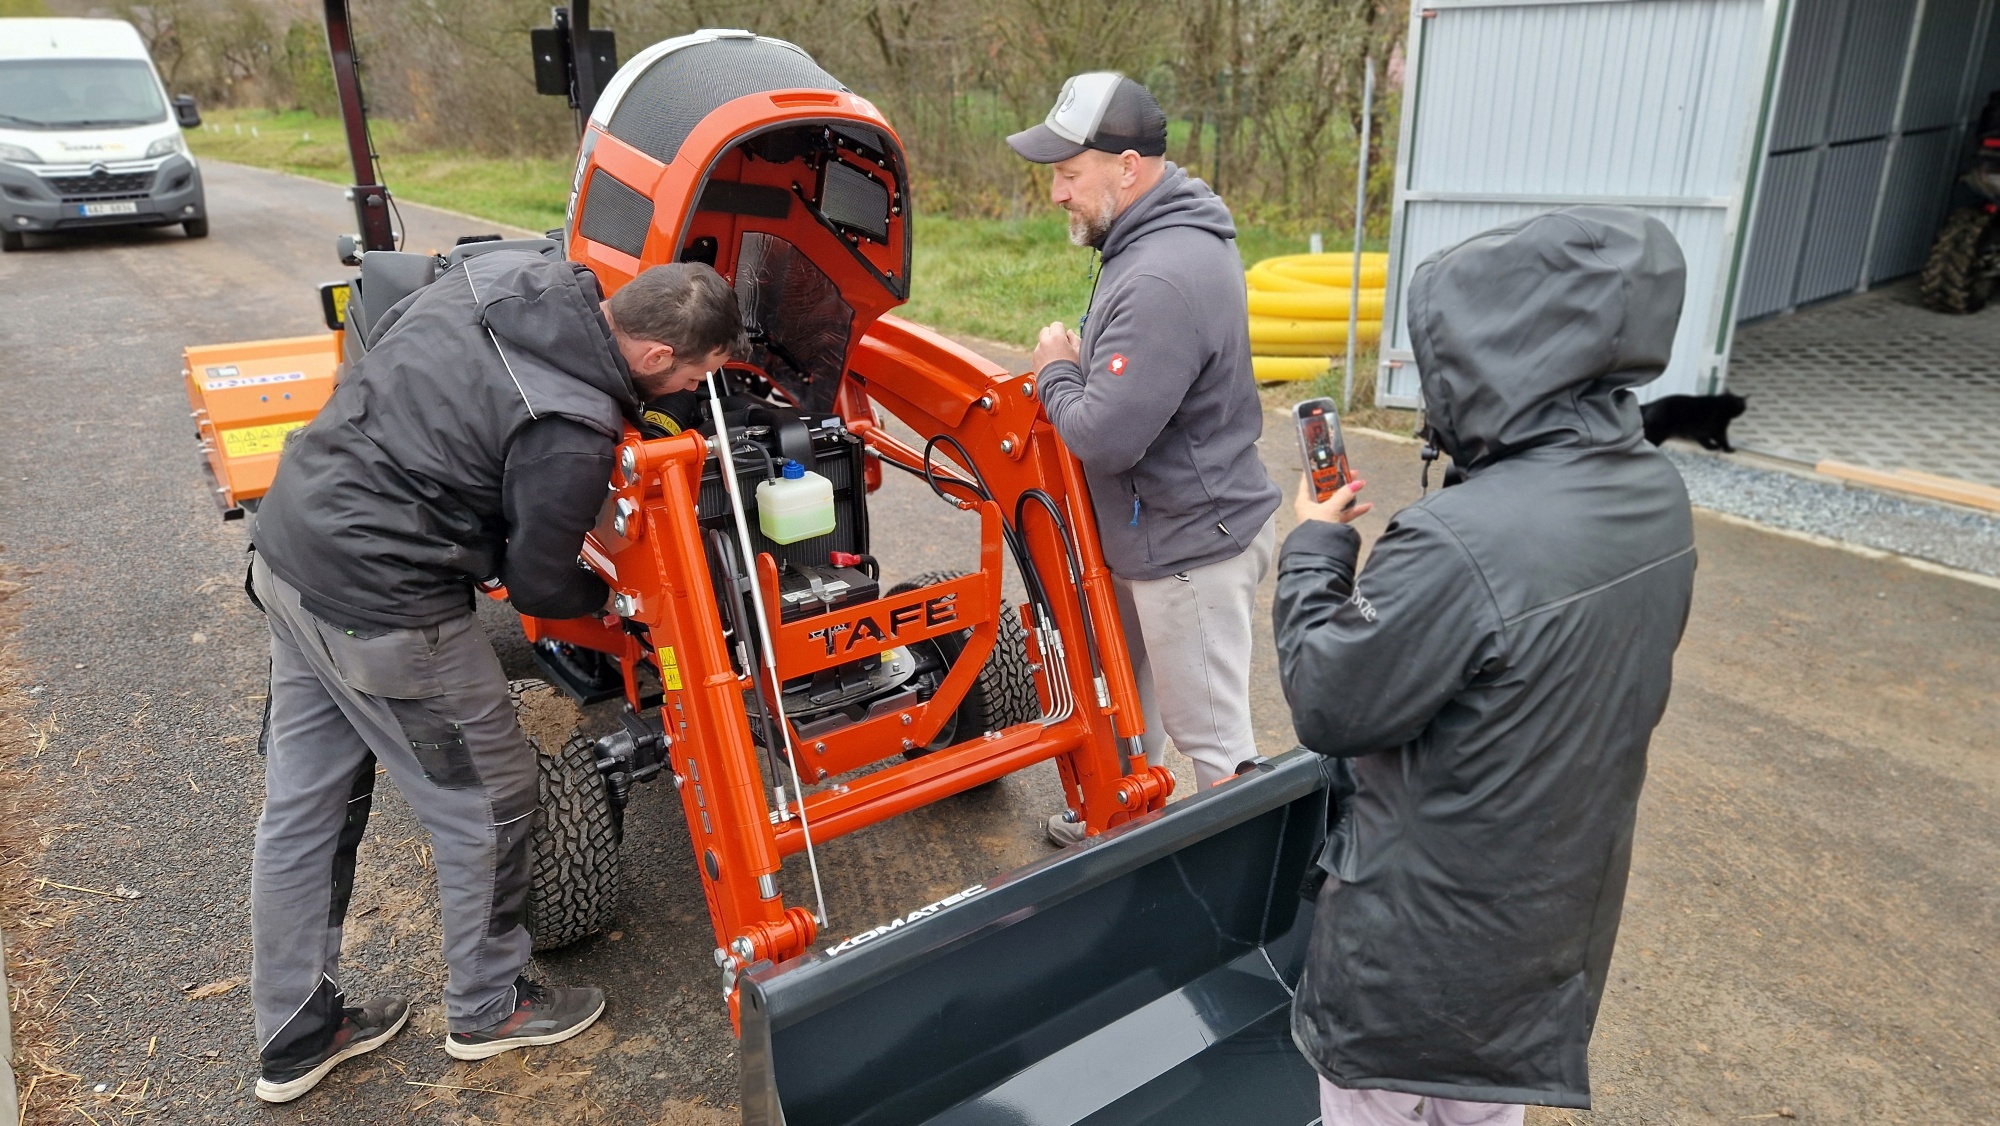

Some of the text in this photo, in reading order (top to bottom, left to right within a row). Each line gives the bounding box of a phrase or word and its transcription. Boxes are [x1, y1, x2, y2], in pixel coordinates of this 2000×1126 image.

[808, 592, 959, 659] TAFE
[675, 694, 687, 742] TL
[825, 884, 987, 956] KOMATEC
